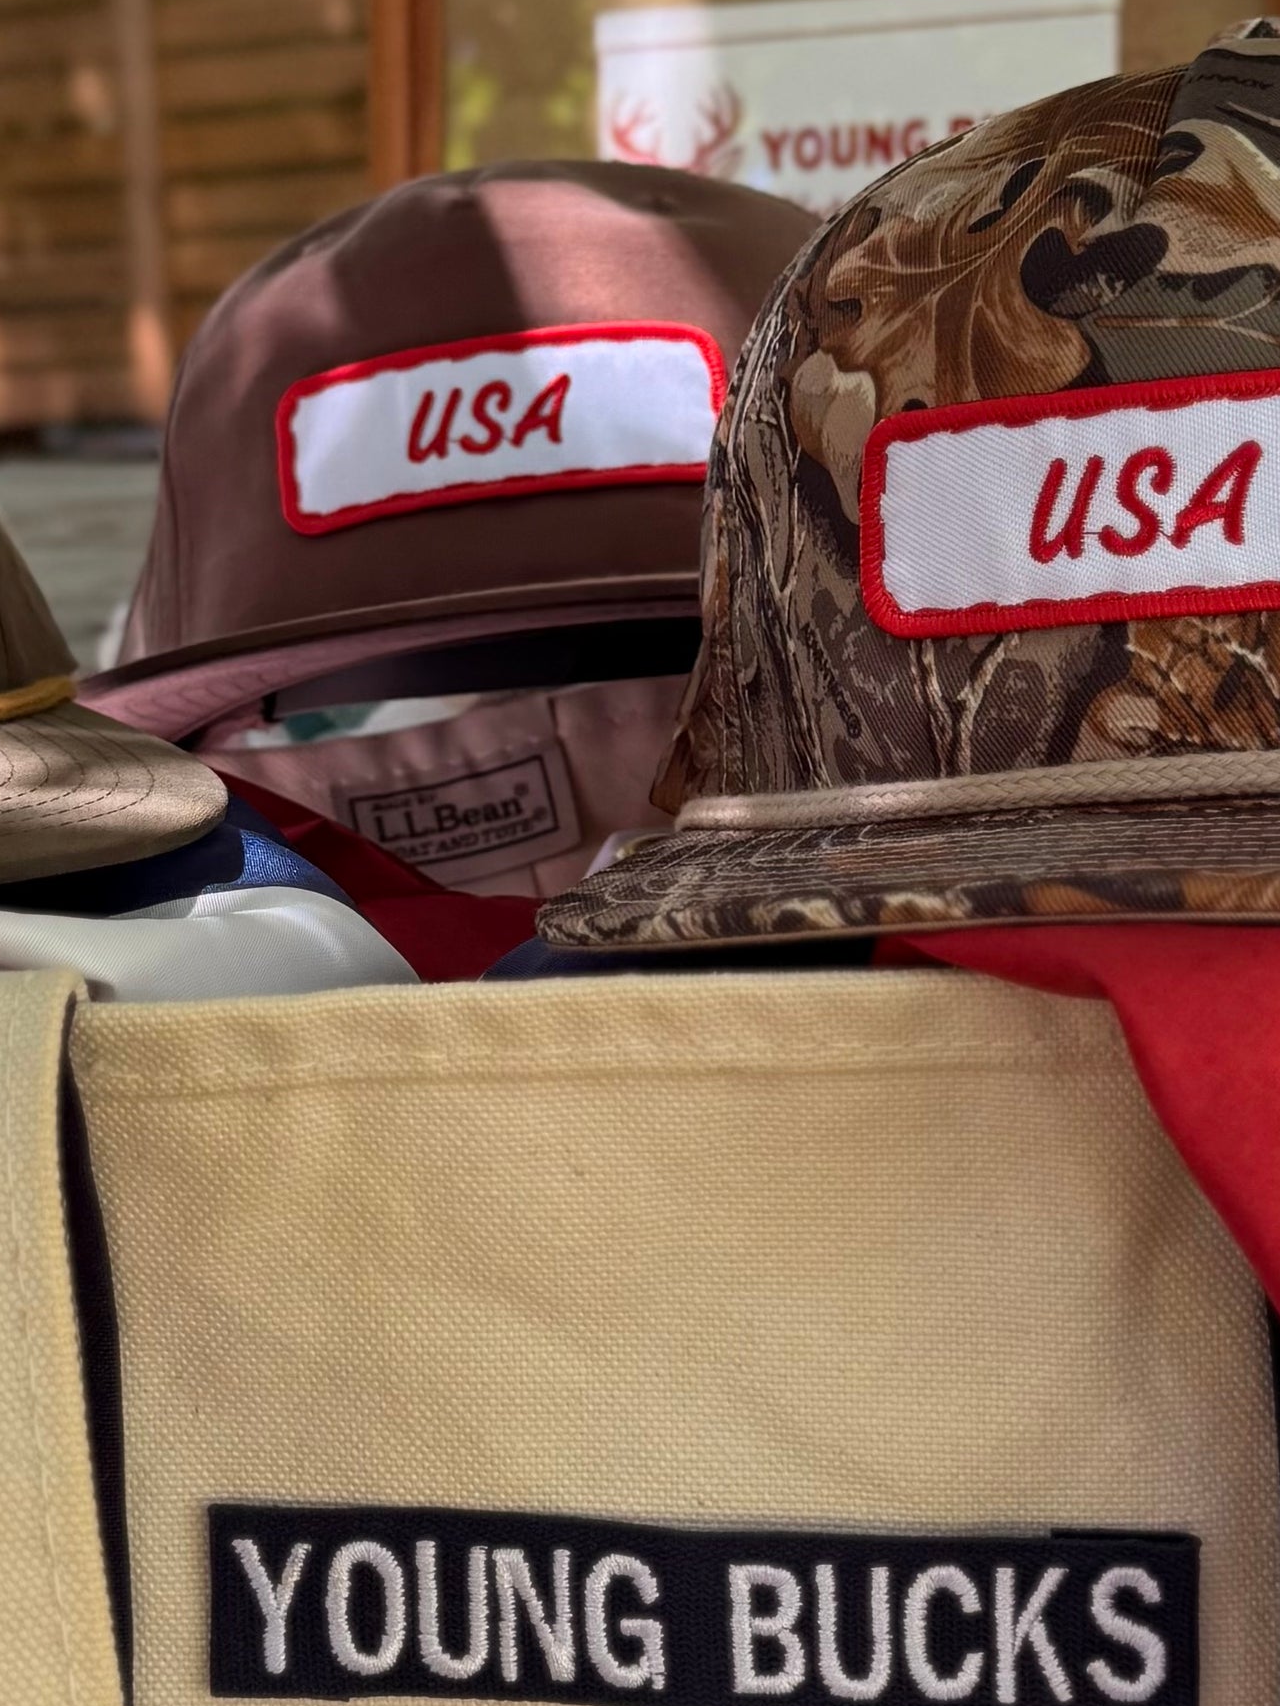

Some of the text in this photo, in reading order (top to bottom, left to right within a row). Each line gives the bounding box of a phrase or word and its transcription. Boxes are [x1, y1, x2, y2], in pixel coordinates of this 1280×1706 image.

[761, 118, 927, 172] YOUNG
[408, 373, 571, 464] USA
[1029, 440, 1263, 564] USA
[393, 840, 434, 859] OAT
[435, 831, 480, 854] AND
[231, 1538, 1166, 1704] YOUNG BUCKS
